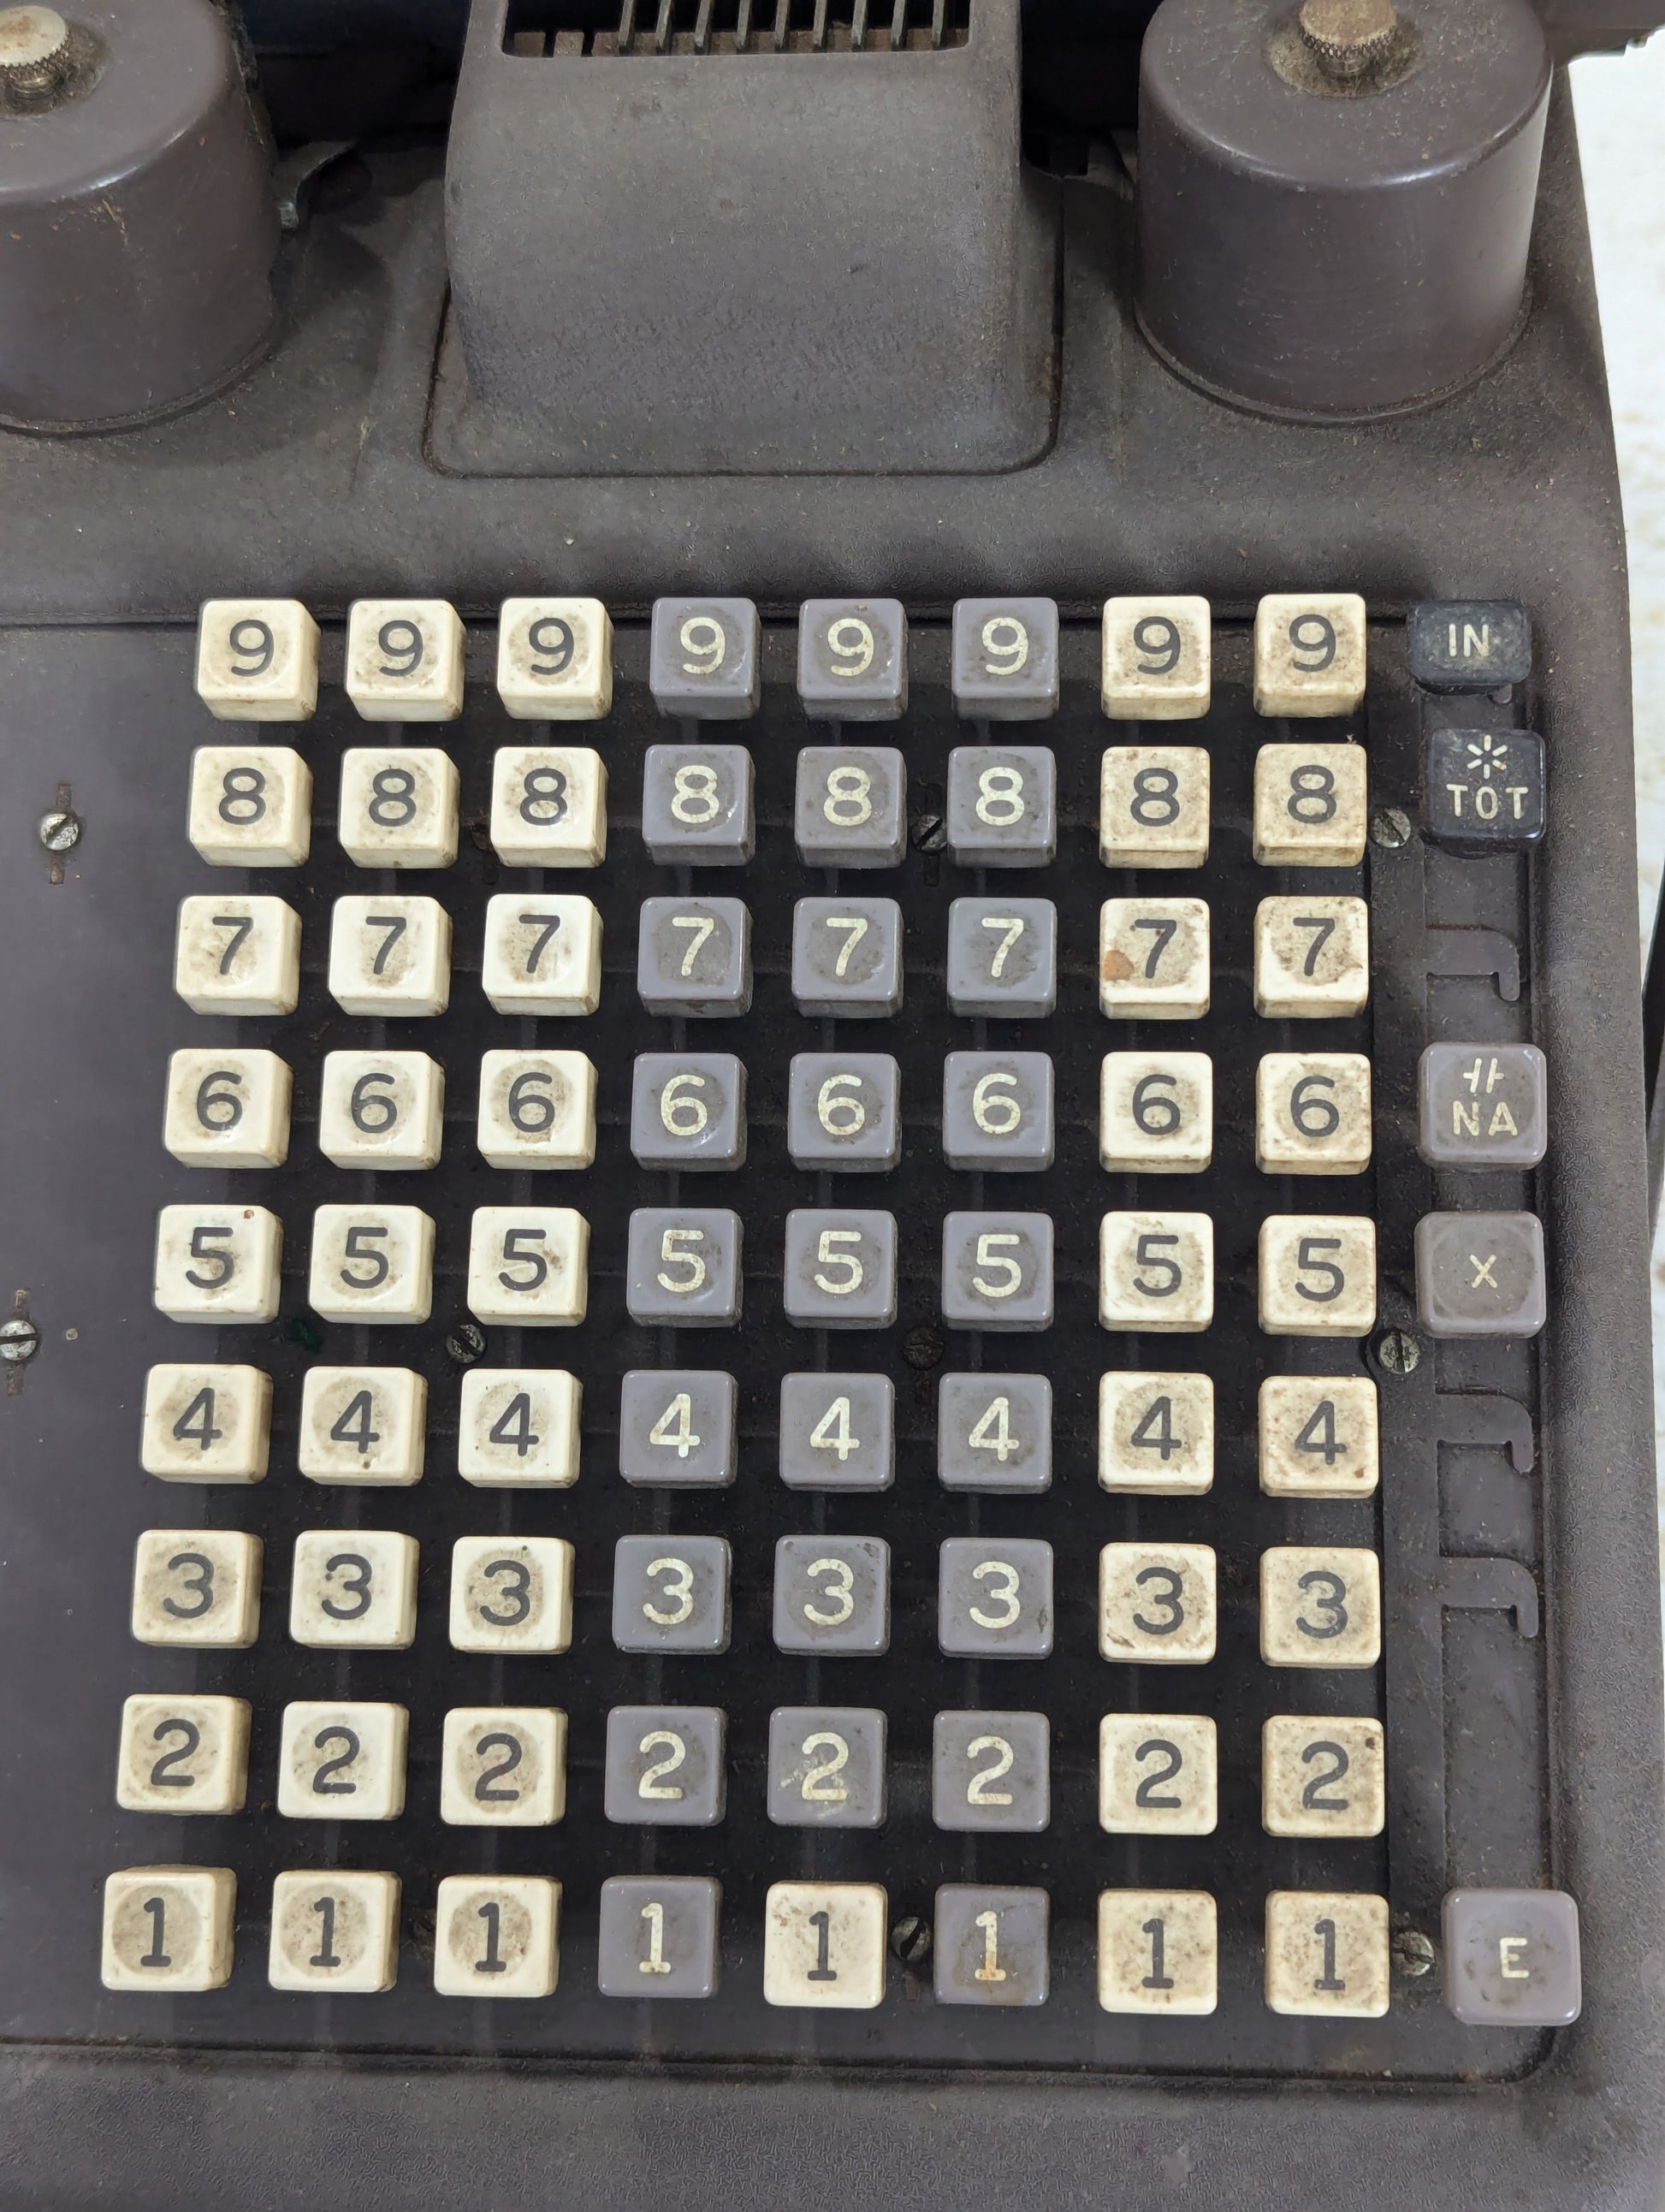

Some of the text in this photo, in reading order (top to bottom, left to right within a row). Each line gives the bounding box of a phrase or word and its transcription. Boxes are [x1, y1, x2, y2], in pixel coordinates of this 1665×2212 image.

[229, 620, 275, 677] 9
[378, 620, 422, 676] 9
[529, 618, 574, 675] 9
[679, 616, 726, 674] 9
[827, 618, 874, 677] 9
[981, 617, 1028, 675] 9
[1134, 616, 1181, 675] 9
[1289, 614, 1336, 672] 9
[1449, 624, 1490, 659] IN
[219, 768, 264, 824] 8
[369, 768, 416, 827] 8
[519, 768, 567, 825] 8
[671, 764, 720, 824] 8
[823, 766, 872, 826] 8
[975, 767, 1025, 827] 8
[1130, 768, 1180, 827] 8
[1288, 765, 1336, 824] 8
[1446, 783, 1529, 820] TOT
[212, 916, 252, 974] 7
[366, 916, 406, 975] 7
[518, 914, 560, 973] 7
[672, 916, 714, 976] 7
[826, 916, 868, 976] 7
[982, 916, 1024, 977] 7
[1135, 919, 1177, 979] 7
[1294, 917, 1335, 976] 7
[196, 1070, 241, 1130] 6
[351, 1072, 397, 1133] 6
[508, 1072, 554, 1133] 6
[661, 1074, 708, 1136] 6
[817, 1074, 865, 1136] 6
[972, 1072, 1021, 1135] 6
[1133, 1074, 1181, 1136] 6
[1290, 1076, 1339, 1137] 6
[1452, 1100, 1518, 1136] NA
[186, 1226, 234, 1289] 5
[340, 1226, 388, 1289] 5
[499, 1229, 548, 1291] 5
[657, 1229, 706, 1293] 5
[814, 1231, 863, 1295] 5
[972, 1234, 1022, 1298] 5
[1134, 1235, 1182, 1297] 5
[1295, 1238, 1344, 1302] 5
[173, 1387, 222, 1450] 4
[330, 1390, 380, 1454] 4
[489, 1392, 539, 1456] 4
[649, 1393, 701, 1456] 4
[809, 1397, 861, 1461] 4
[968, 1397, 1020, 1462] 4
[1131, 1396, 1182, 1461] 4
[1295, 1401, 1347, 1463] 4
[163, 1553, 213, 1618] 3
[321, 1553, 372, 1620] 3
[479, 1560, 530, 1627] 3
[643, 1557, 694, 1625] 3
[803, 1558, 854, 1625] 3
[969, 1561, 1021, 1629] 3
[1133, 1567, 1184, 1635] 3
[1296, 1571, 1348, 1639] 3
[151, 1718, 199, 1787] 2
[312, 1726, 359, 1794] 2
[475, 1733, 522, 1801] 2
[638, 1730, 686, 1800] 2
[801, 1732, 849, 1800] 2
[967, 1735, 1014, 1806] 2
[1135, 1739, 1182, 1808] 2
[1301, 1741, 1349, 1811] 2
[140, 1897, 171, 1967] 1
[310, 1897, 341, 1967] 1
[475, 1902, 507, 1972] 1
[638, 1902, 672, 1973] 1
[808, 1911, 837, 1981] 1
[974, 1911, 1006, 1981] 1
[1142, 1918, 1174, 1990] 1
[1314, 1919, 1345, 1990] 1
[1499, 1936, 1530, 1978] E
